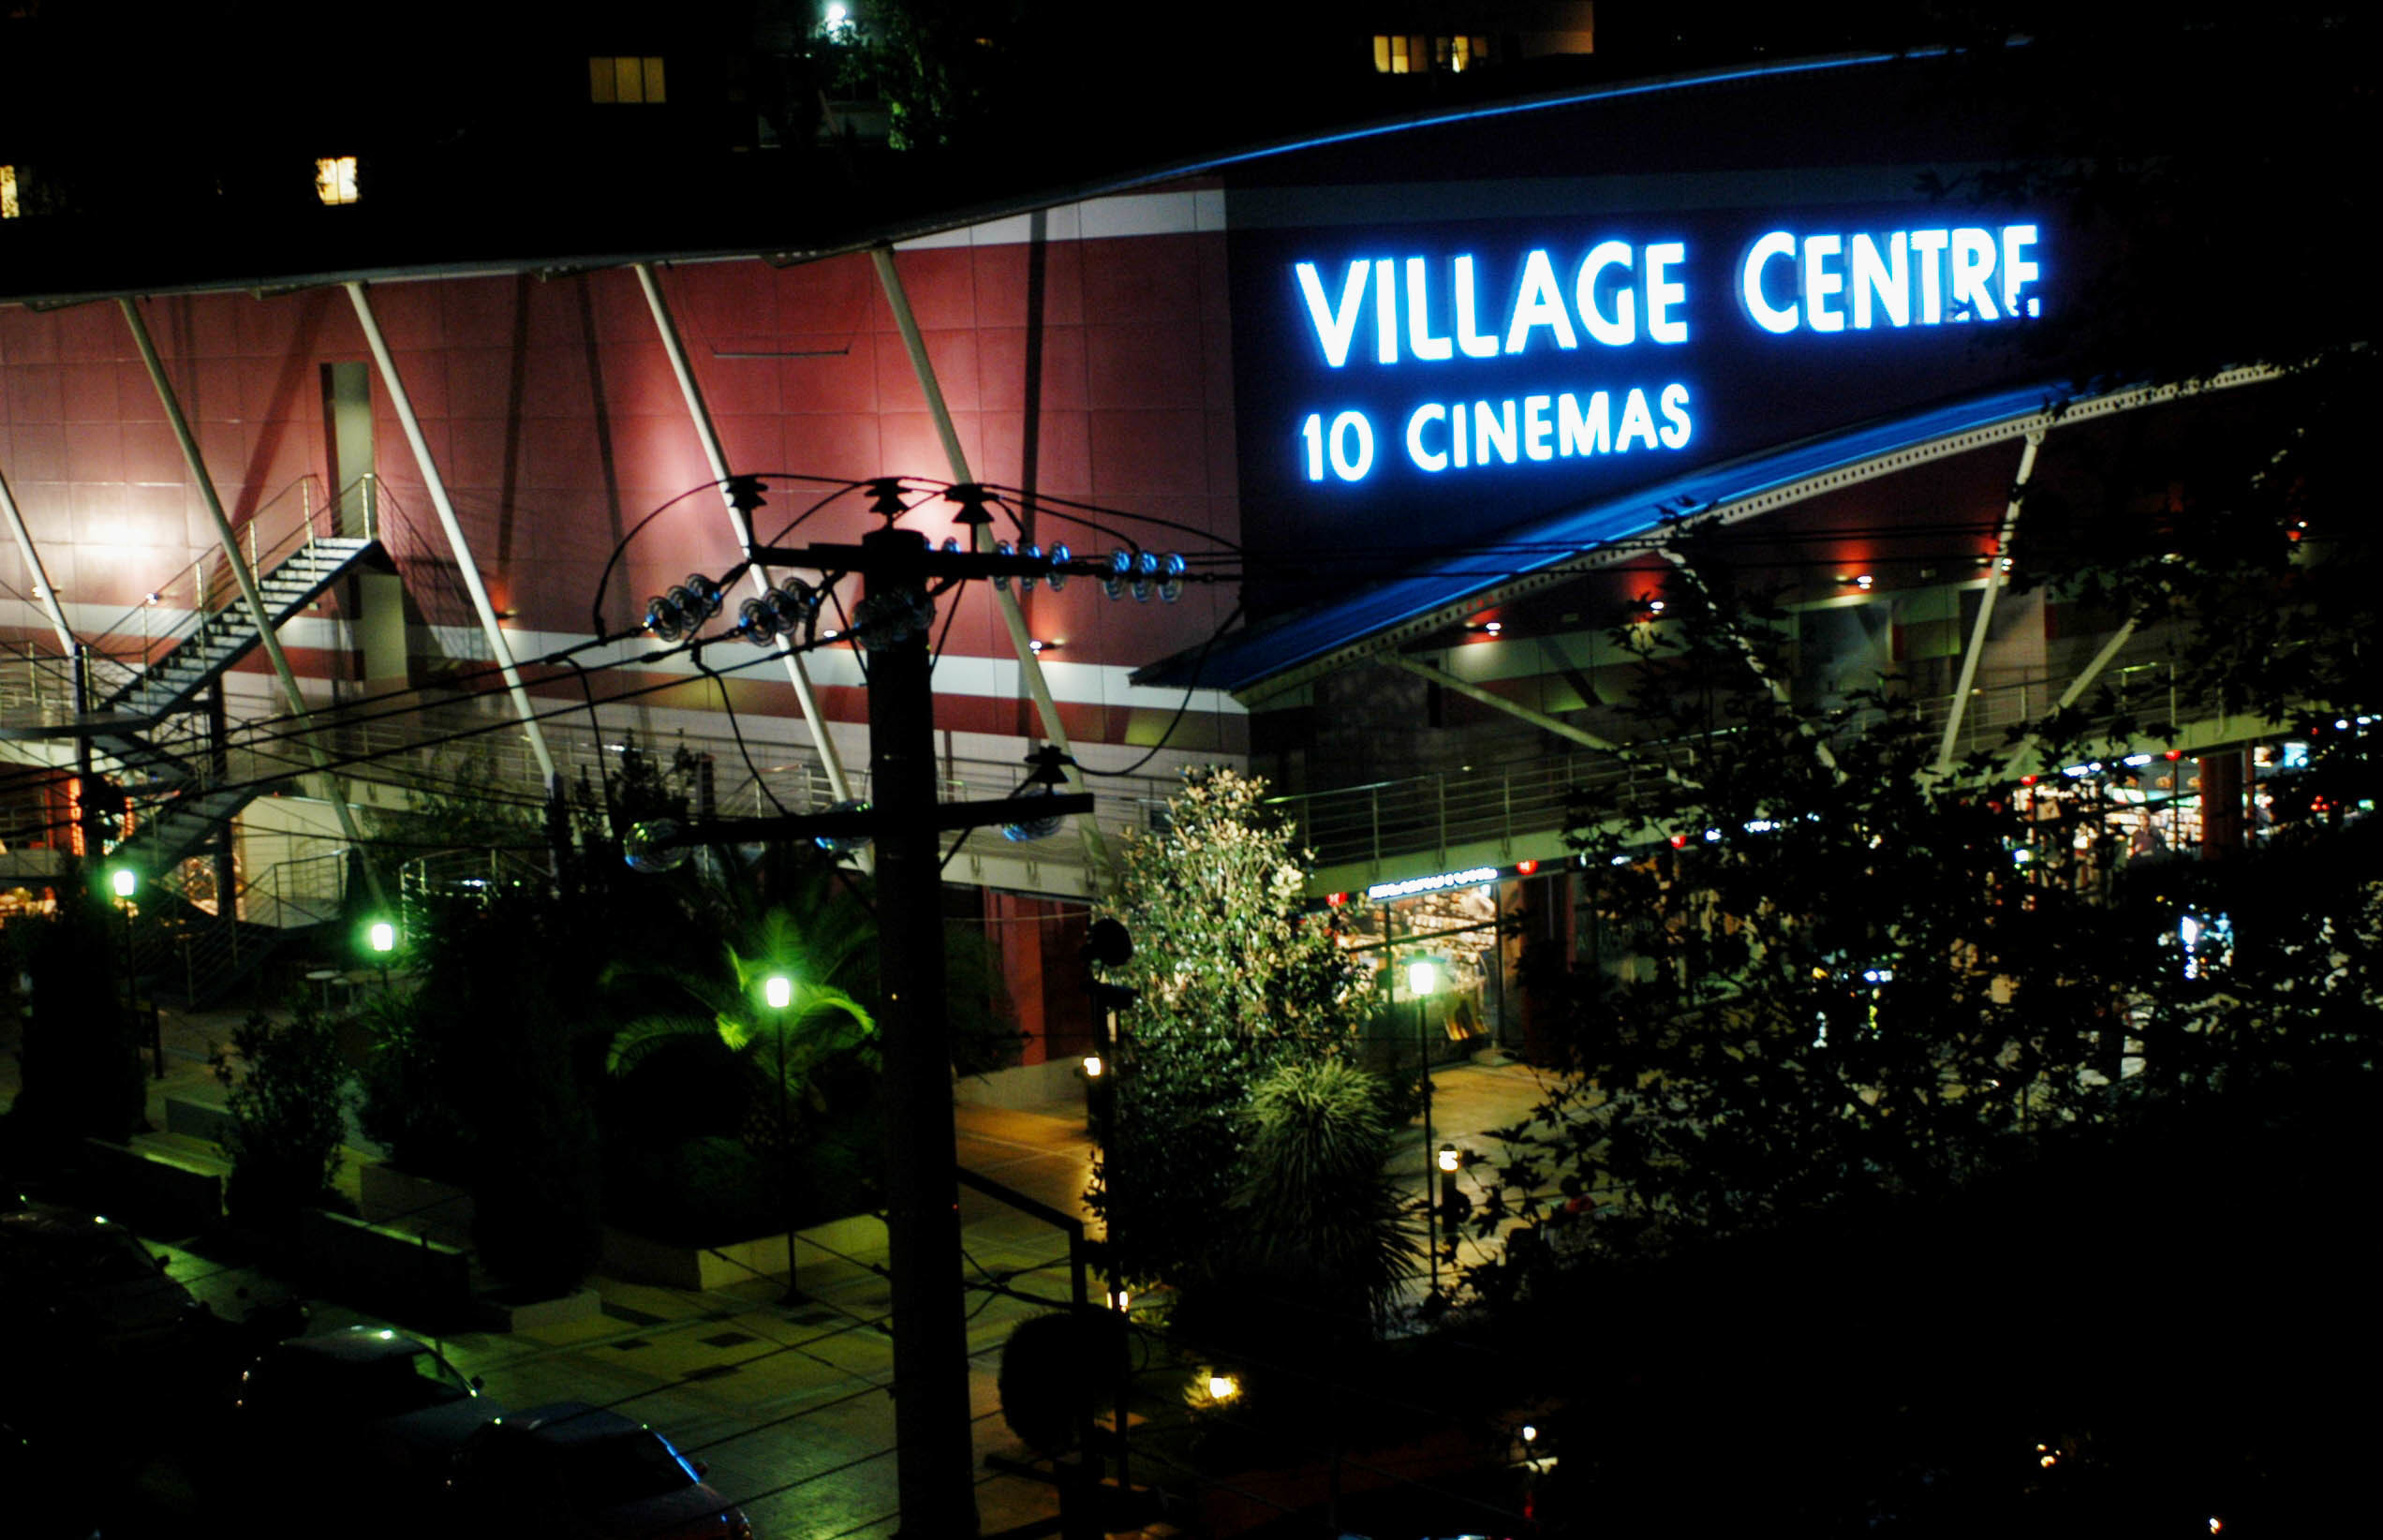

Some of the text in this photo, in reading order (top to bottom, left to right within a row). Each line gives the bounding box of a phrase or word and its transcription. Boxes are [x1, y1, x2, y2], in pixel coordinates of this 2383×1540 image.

[1295, 224, 2040, 367] VILLAGE CENTRE
[1302, 383, 1692, 481] 10 CINEMAS
